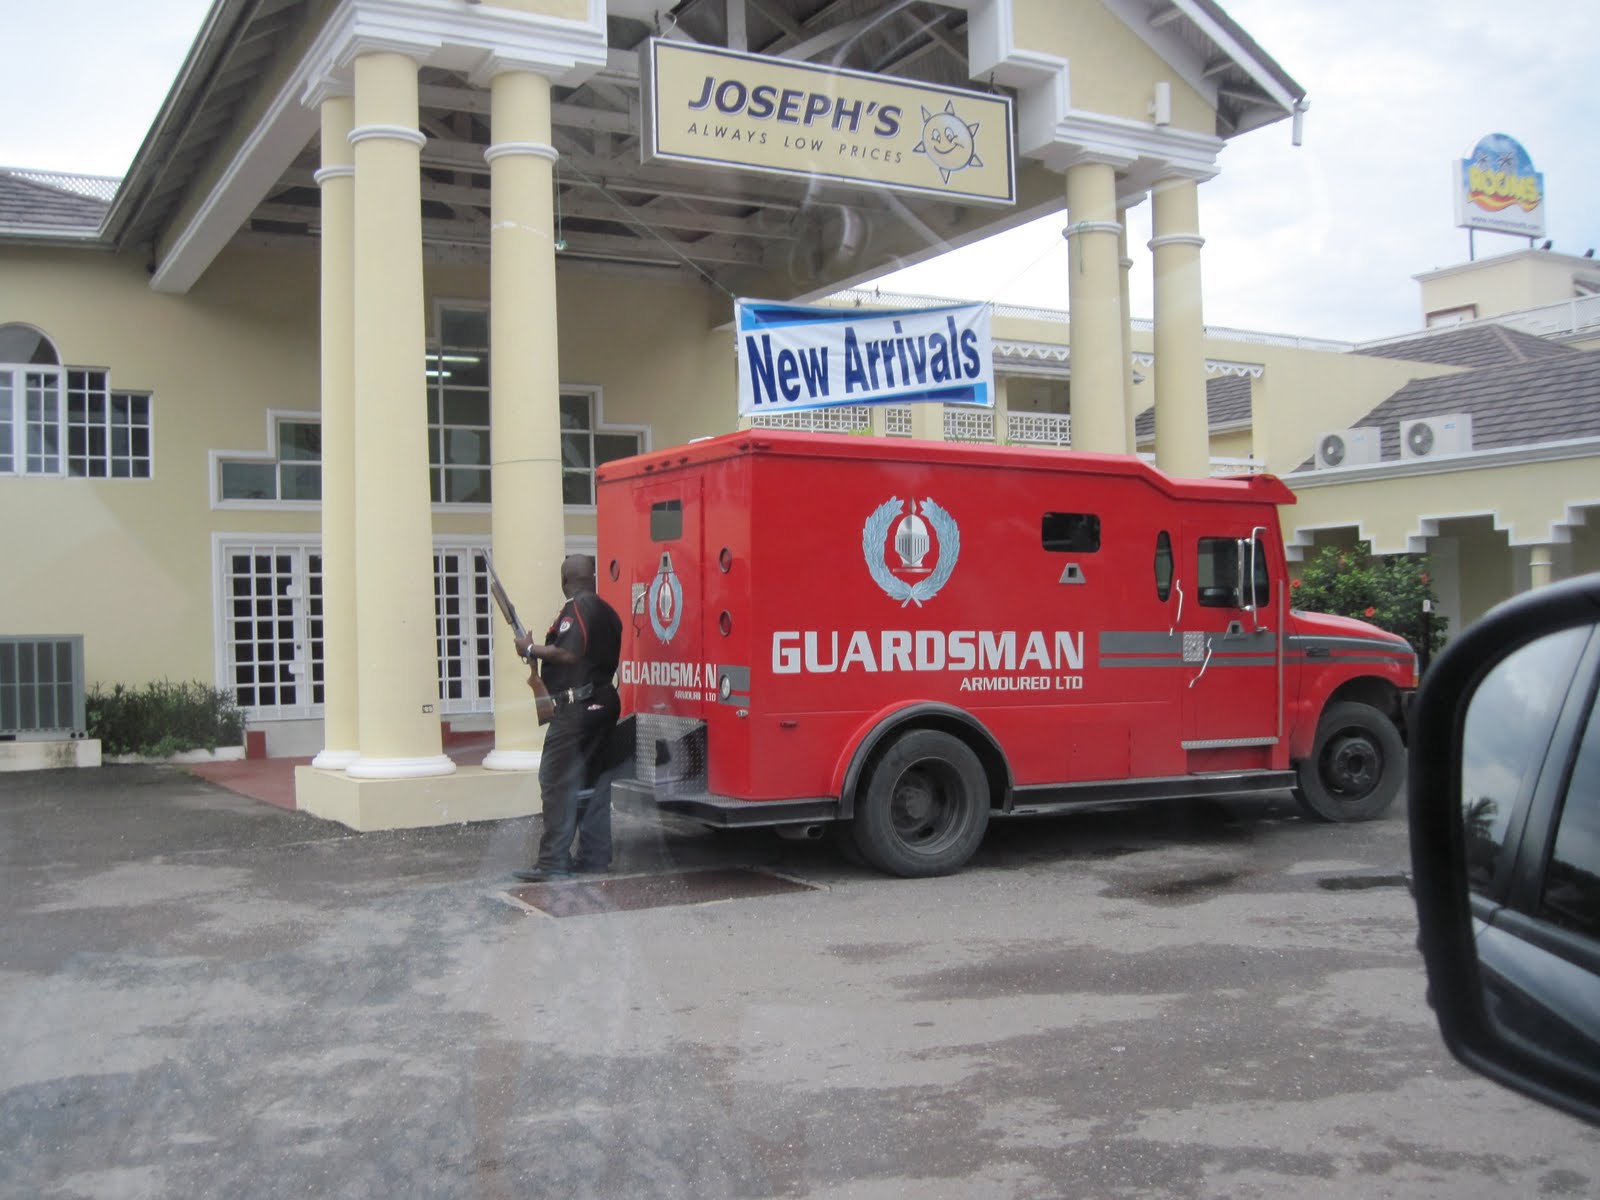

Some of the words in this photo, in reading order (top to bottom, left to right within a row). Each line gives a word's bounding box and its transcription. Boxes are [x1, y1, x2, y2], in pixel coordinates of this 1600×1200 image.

[687, 76, 904, 138] JOSEPH'S
[688, 122, 768, 145] ALWAYS
[784, 135, 824, 152] LOW
[839, 143, 904, 164] PRICES
[745, 334, 831, 405] New
[844, 315, 981, 394] Arrivals
[772, 630, 1084, 674] GUARDSMAN
[621, 660, 718, 689] GUARDSMAN
[960, 676, 1051, 692] ARMOURED
[1055, 675, 1084, 690] LTD
[705, 691, 717, 702] LTD
